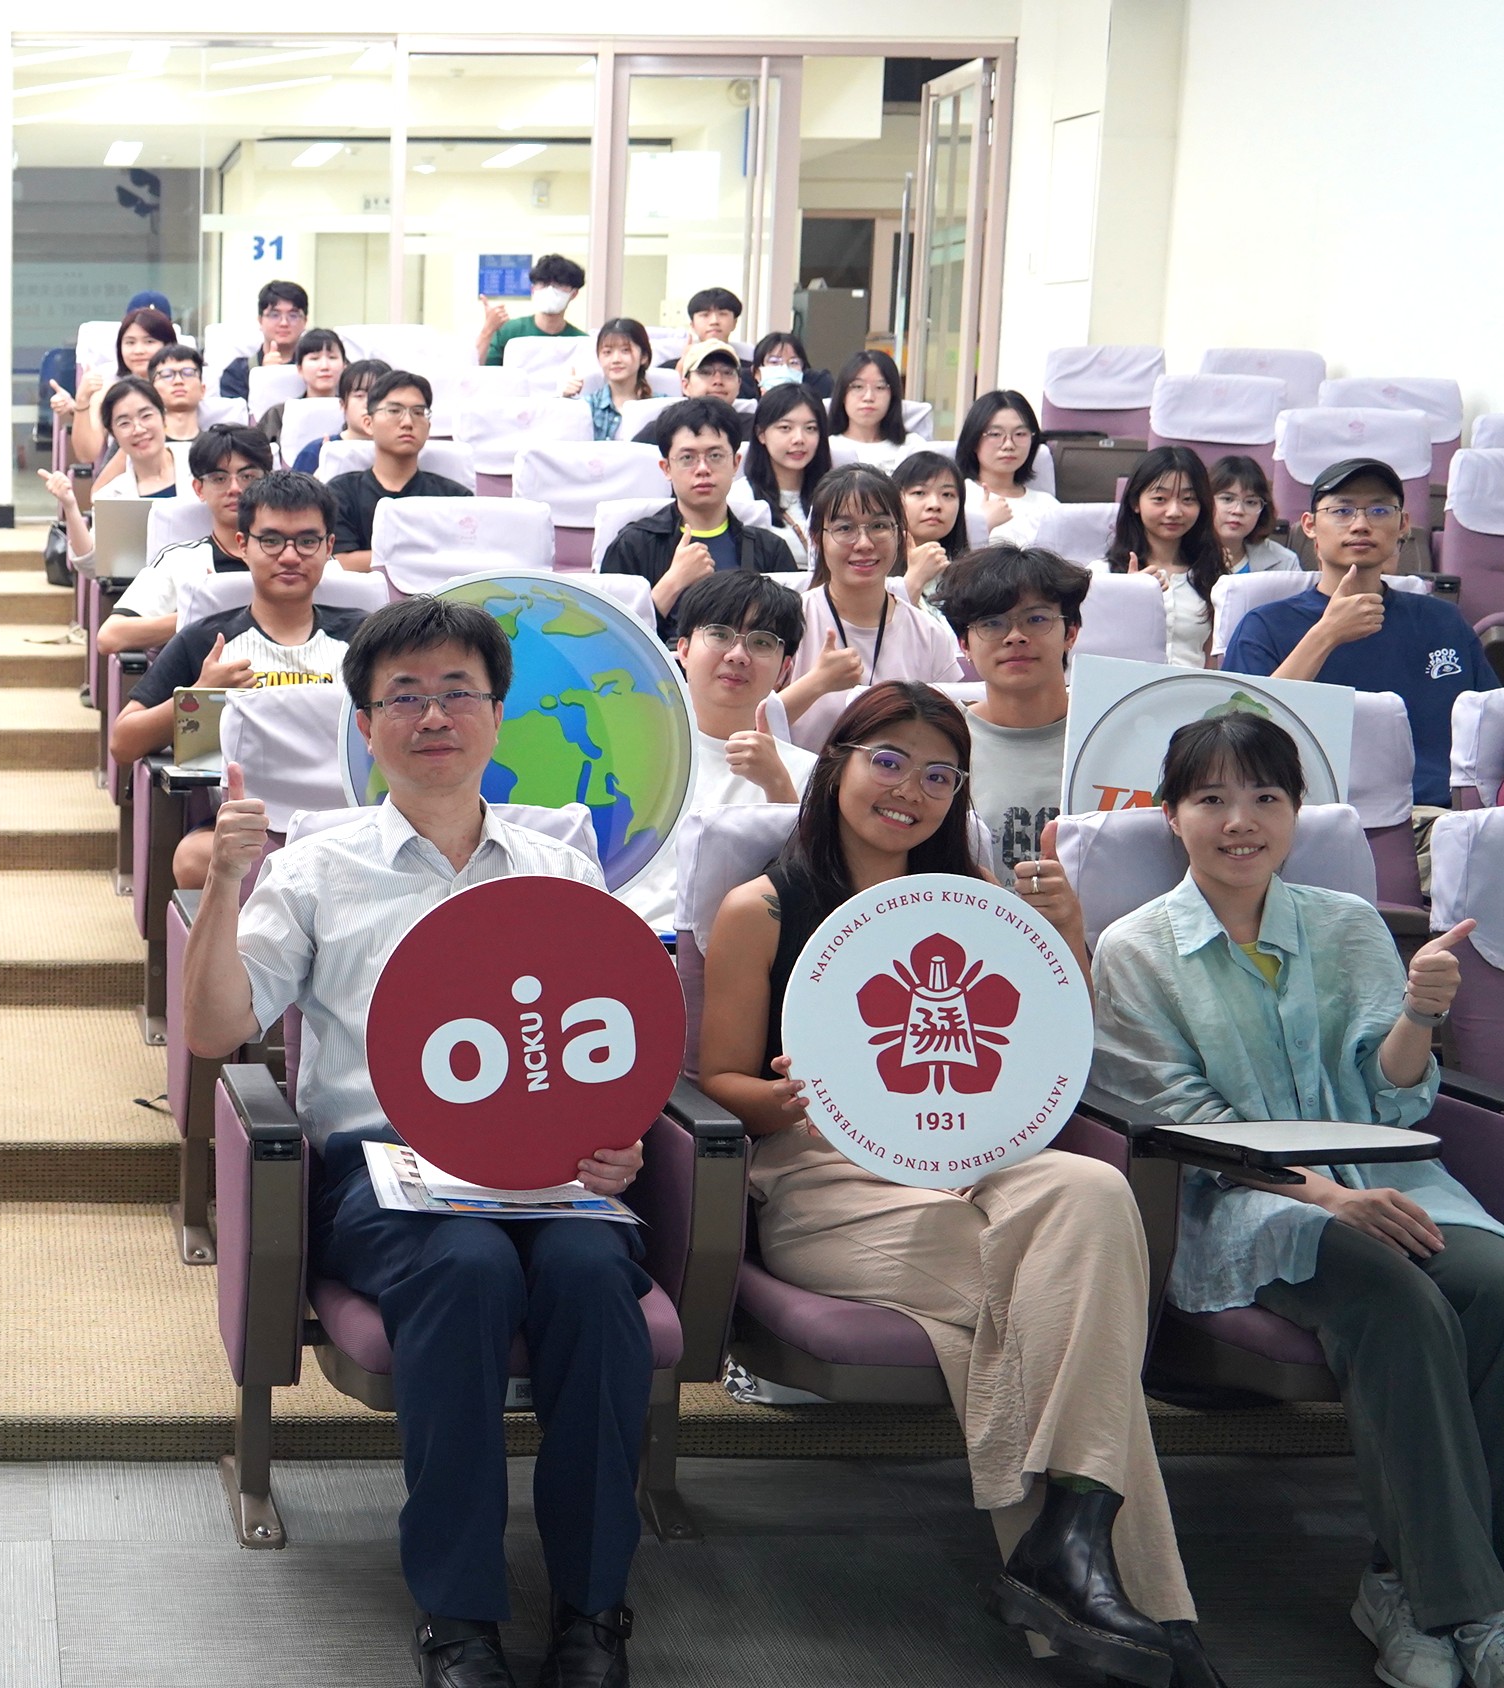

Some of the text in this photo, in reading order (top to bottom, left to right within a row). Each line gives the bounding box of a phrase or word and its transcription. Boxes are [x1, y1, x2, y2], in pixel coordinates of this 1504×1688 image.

[1428, 648, 1456, 662] FOOD
[809, 891, 1069, 988] NATIONAL CHENG KUNG UNIVERSITY
[519, 1012, 550, 1093] NCKU
[810, 1075, 1069, 1172] NATIONAL CHENG KUNG UNIVERSITY
[915, 1112, 966, 1131] 1931
